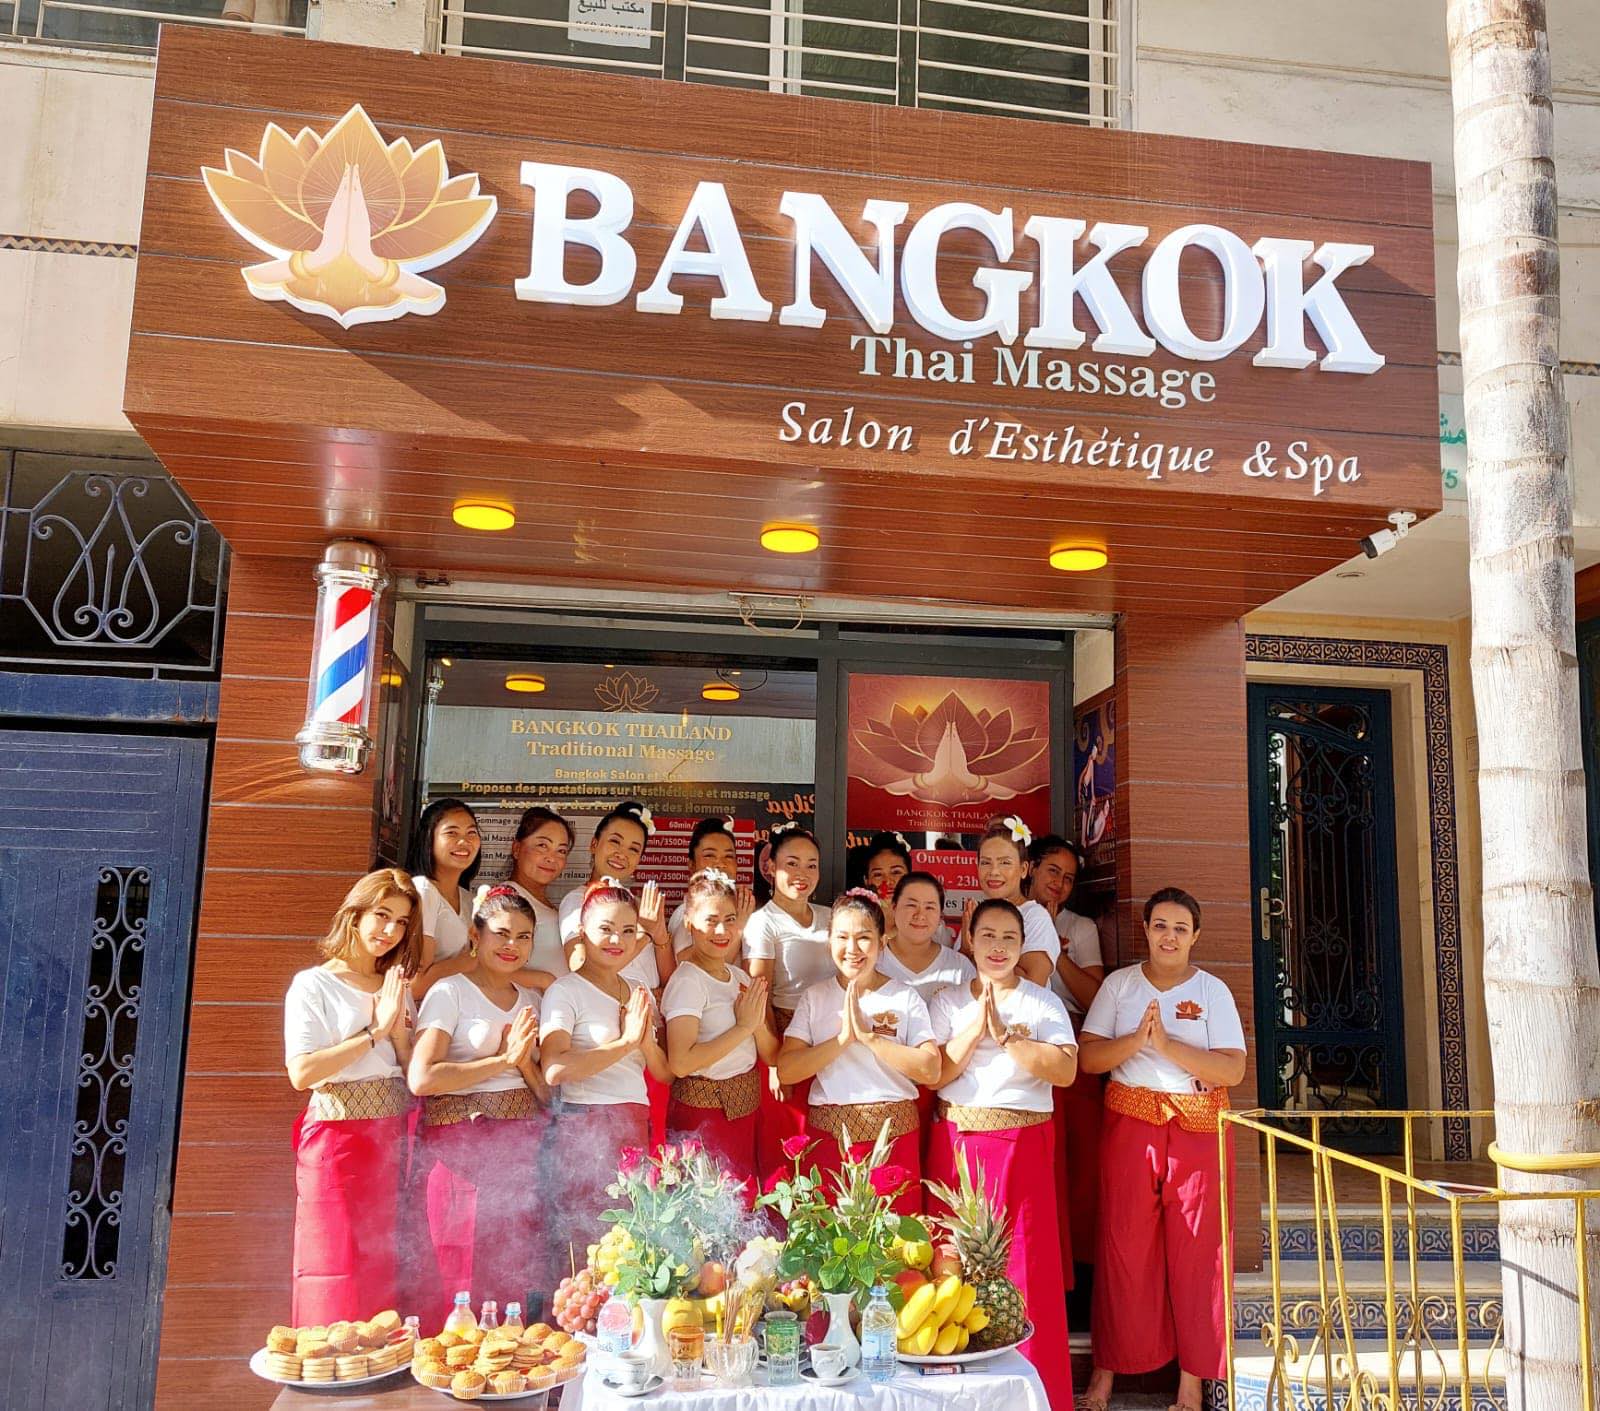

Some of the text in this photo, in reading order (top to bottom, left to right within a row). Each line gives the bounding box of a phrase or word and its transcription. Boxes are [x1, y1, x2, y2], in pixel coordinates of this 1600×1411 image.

[612, 1, 646, 15] مكتب
[514, 161, 1385, 374] BANGKOK
[850, 335, 1217, 409] Thai Massage
[779, 401, 913, 452] Salon
[948, 416, 1215, 481] d'Esthétique
[510, 719, 733, 742] BANGKOK THAILAND
[527, 741, 716, 763] Traditional Massage
[555, 768, 607, 782] Bangkok
[610, 769, 645, 781] Salon
[461, 782, 512, 795] Propose
[515, 783, 536, 794] des
[539, 783, 608, 796] prestations
[610, 786, 630, 797] sur
[706, 788, 719, 799] et
[721, 789, 771, 802] massage
[662, 802, 683, 813] des
[685, 803, 736, 815] Hommes
[896, 808, 949, 819] BANGKOK
[908, 819, 985, 830] Traditional Massa
